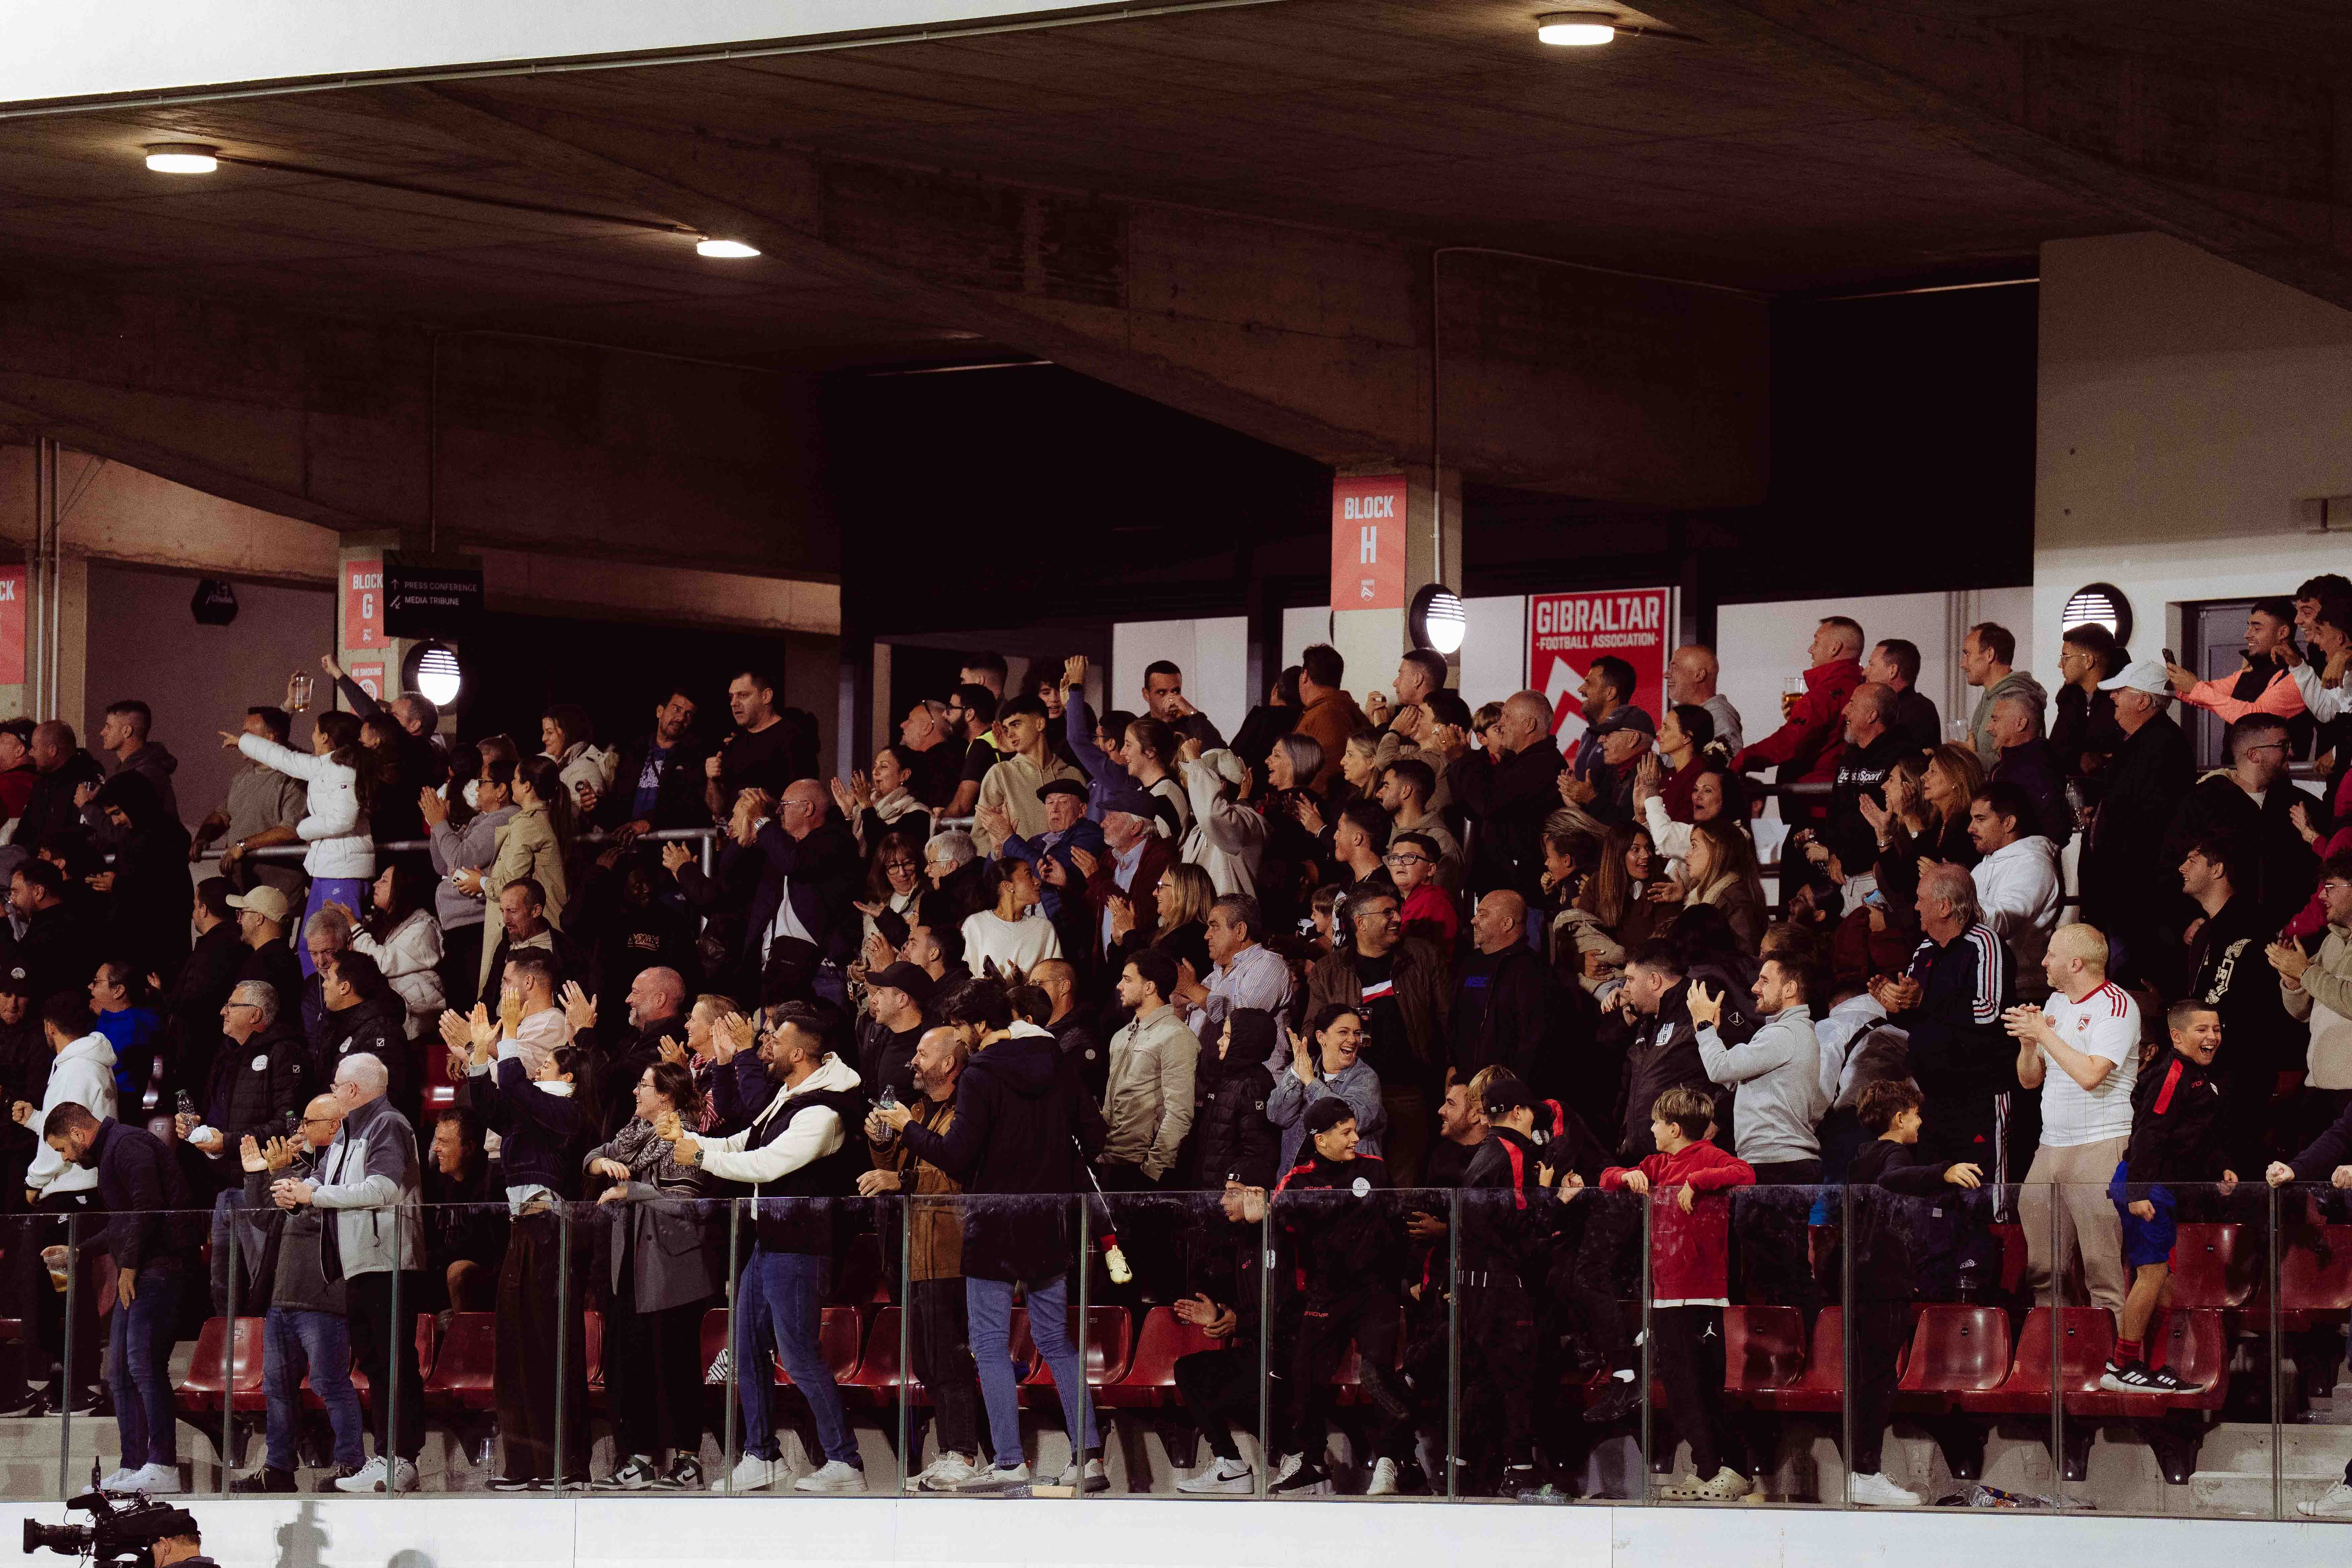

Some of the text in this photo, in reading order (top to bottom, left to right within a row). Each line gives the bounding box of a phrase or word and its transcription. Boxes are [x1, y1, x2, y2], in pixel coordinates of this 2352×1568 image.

[1345, 495, 1394, 519] BLOCK
[1361, 526, 1377, 564] H
[353, 574, 383, 590] BLOCK
[405, 581, 477, 592] PRESS CONFERENCE
[362, 593, 373, 620] G
[430, 597, 459, 606] TRIBUNE
[1536, 597, 1660, 634] GIBRALTAR
[1539, 632, 1655, 650] FOOTBALL ASSOCIATION
[352, 667, 382, 677] NO SMOKING
